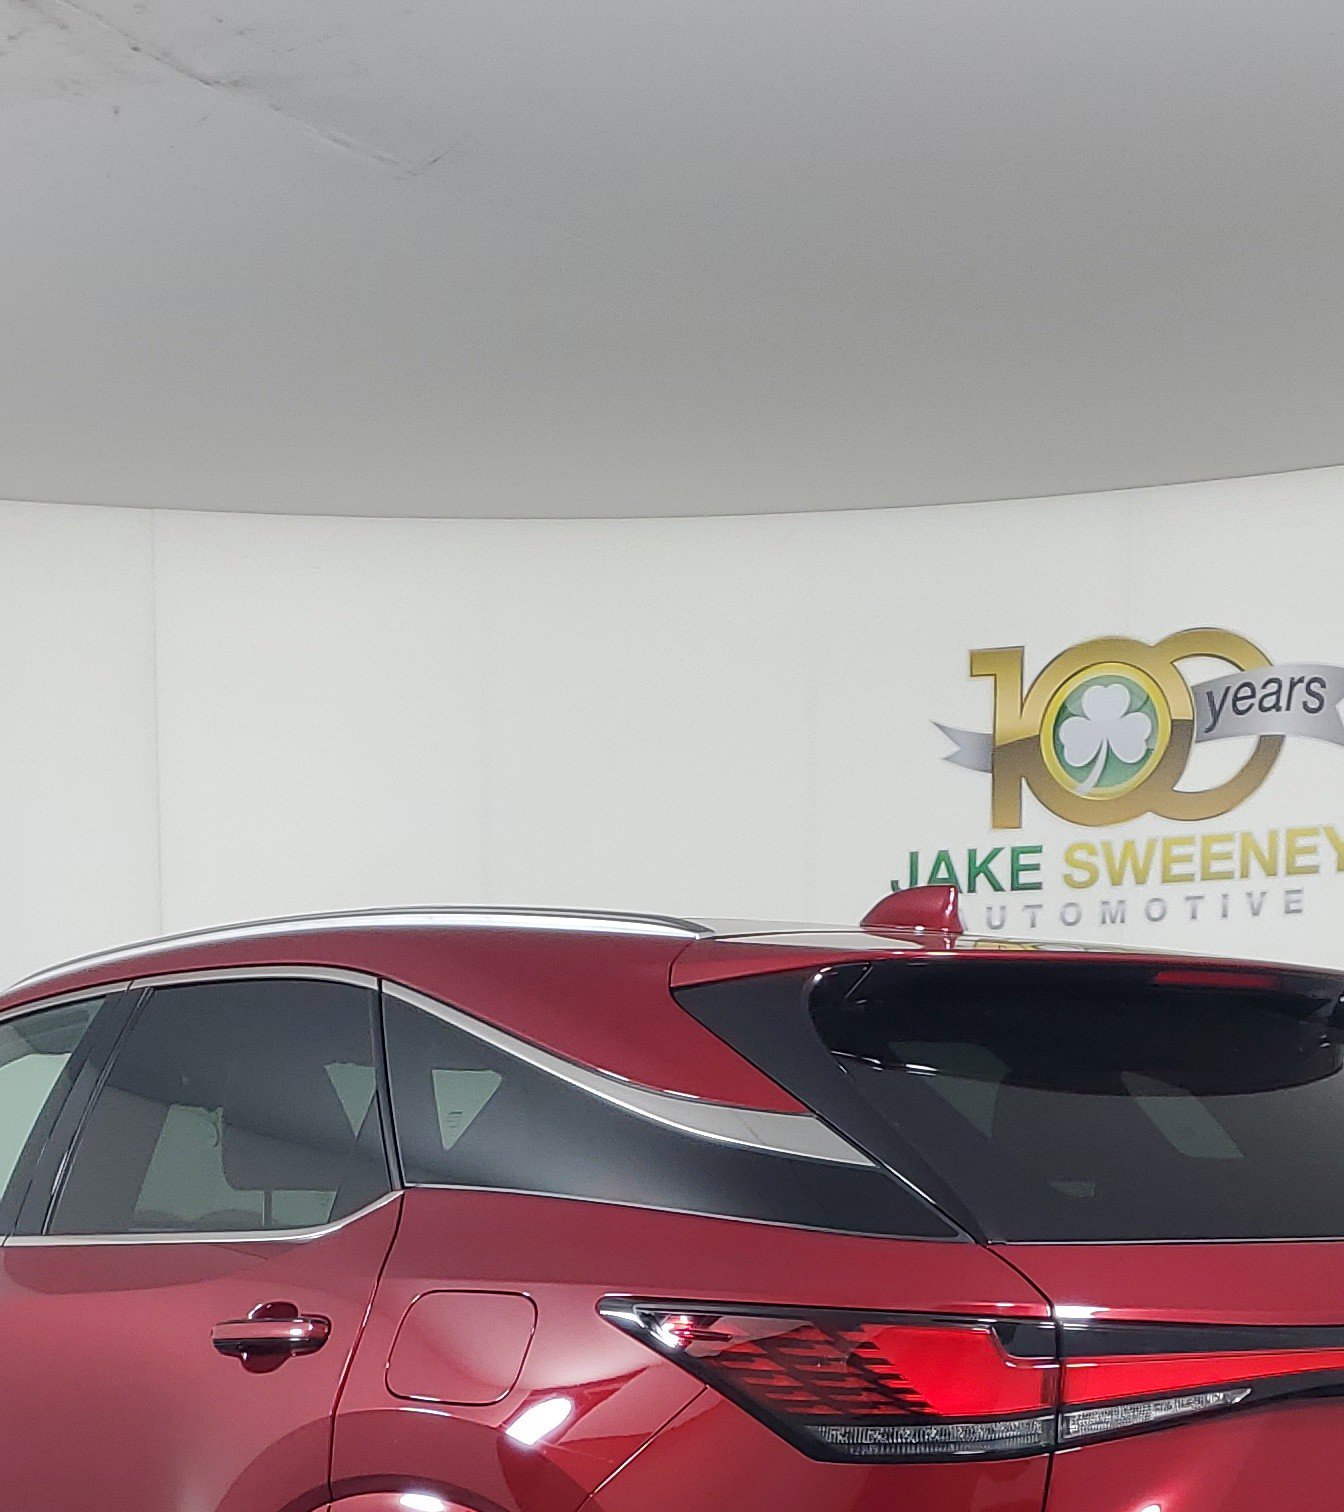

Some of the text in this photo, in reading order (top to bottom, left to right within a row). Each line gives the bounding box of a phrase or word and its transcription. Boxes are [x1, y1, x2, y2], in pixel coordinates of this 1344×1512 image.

[970, 627, 1287, 829] 100
[1203, 674, 1327, 733] years
[891, 844, 1044, 894] JAKE
[960, 889, 1305, 931] UTOMOTIVE
